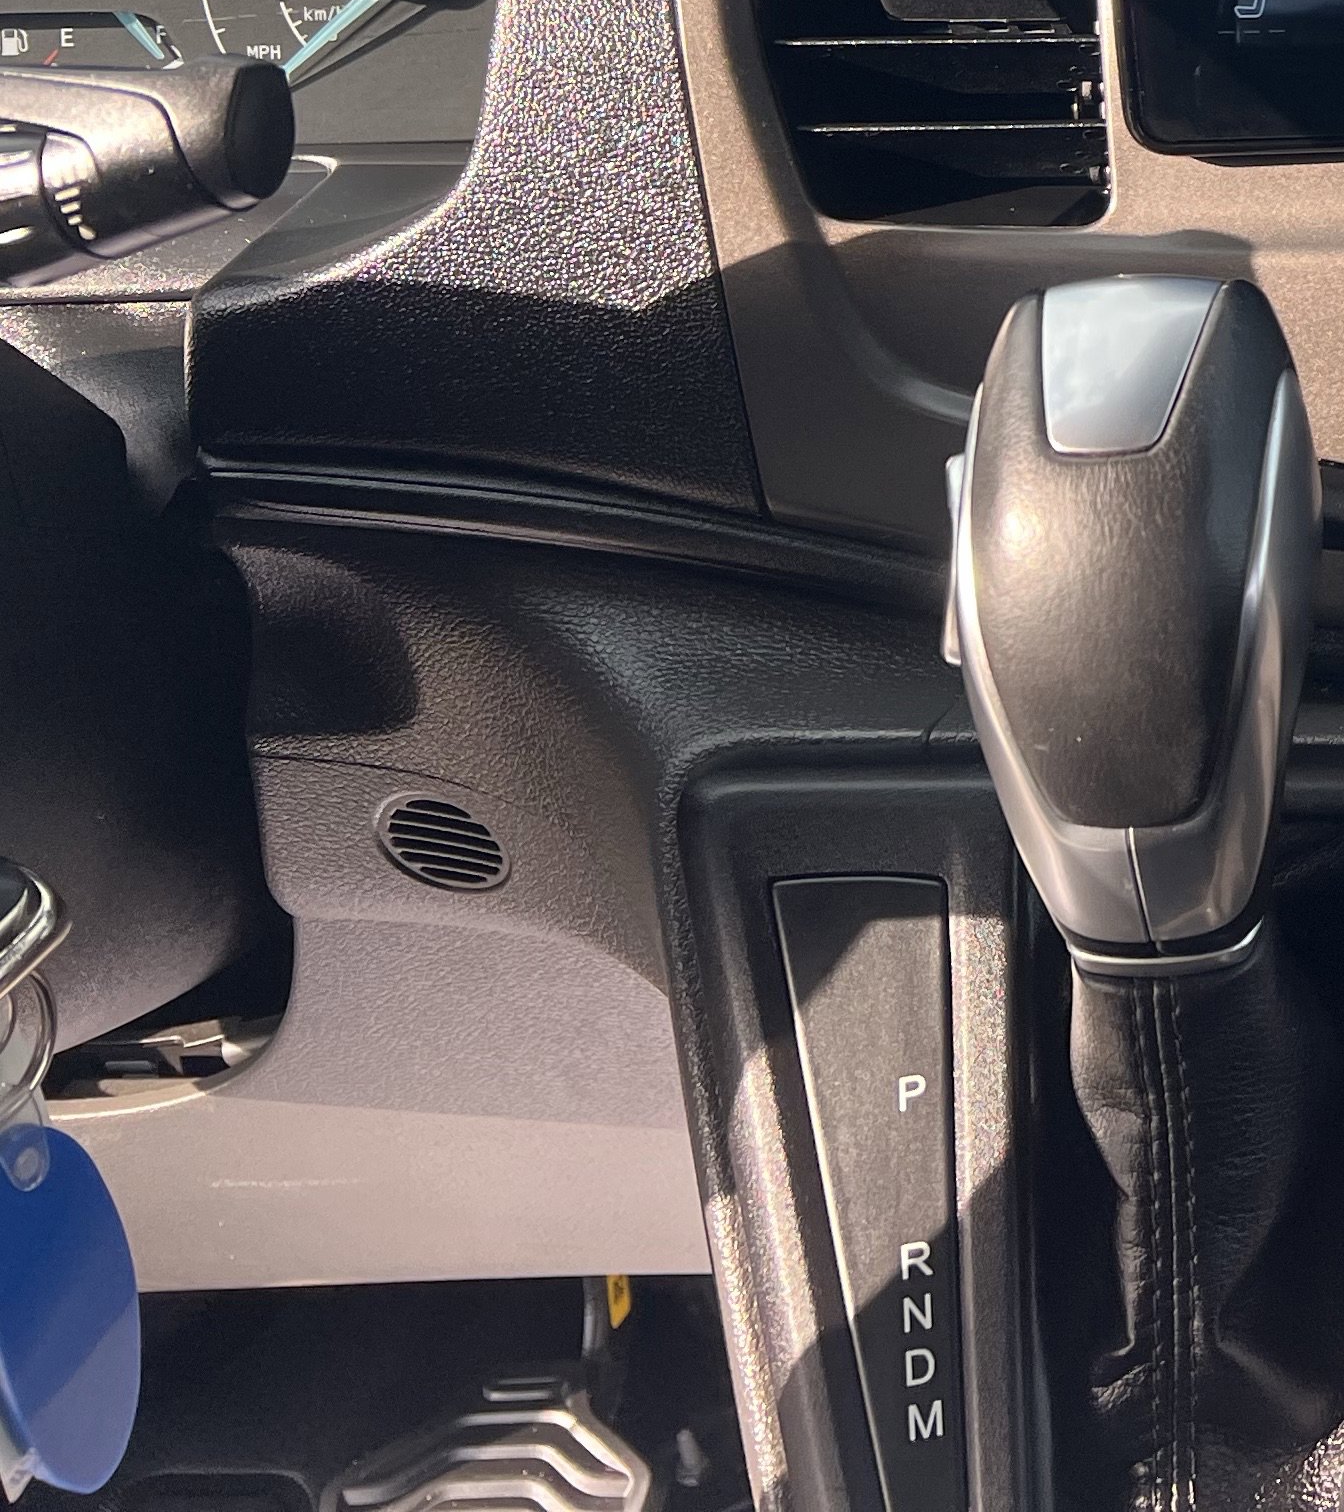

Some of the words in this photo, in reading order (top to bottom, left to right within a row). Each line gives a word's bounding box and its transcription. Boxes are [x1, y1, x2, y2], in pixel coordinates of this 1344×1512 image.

[60, 27, 75, 48] E
[155, 24, 168, 45] F
[246, 44, 282, 60] MPH
[898, 1074, 927, 1113] P
[899, 1240, 934, 1281] R
[903, 1292, 933, 1334] N
[905, 1348, 935, 1387] D
[908, 1399, 944, 1443] M
